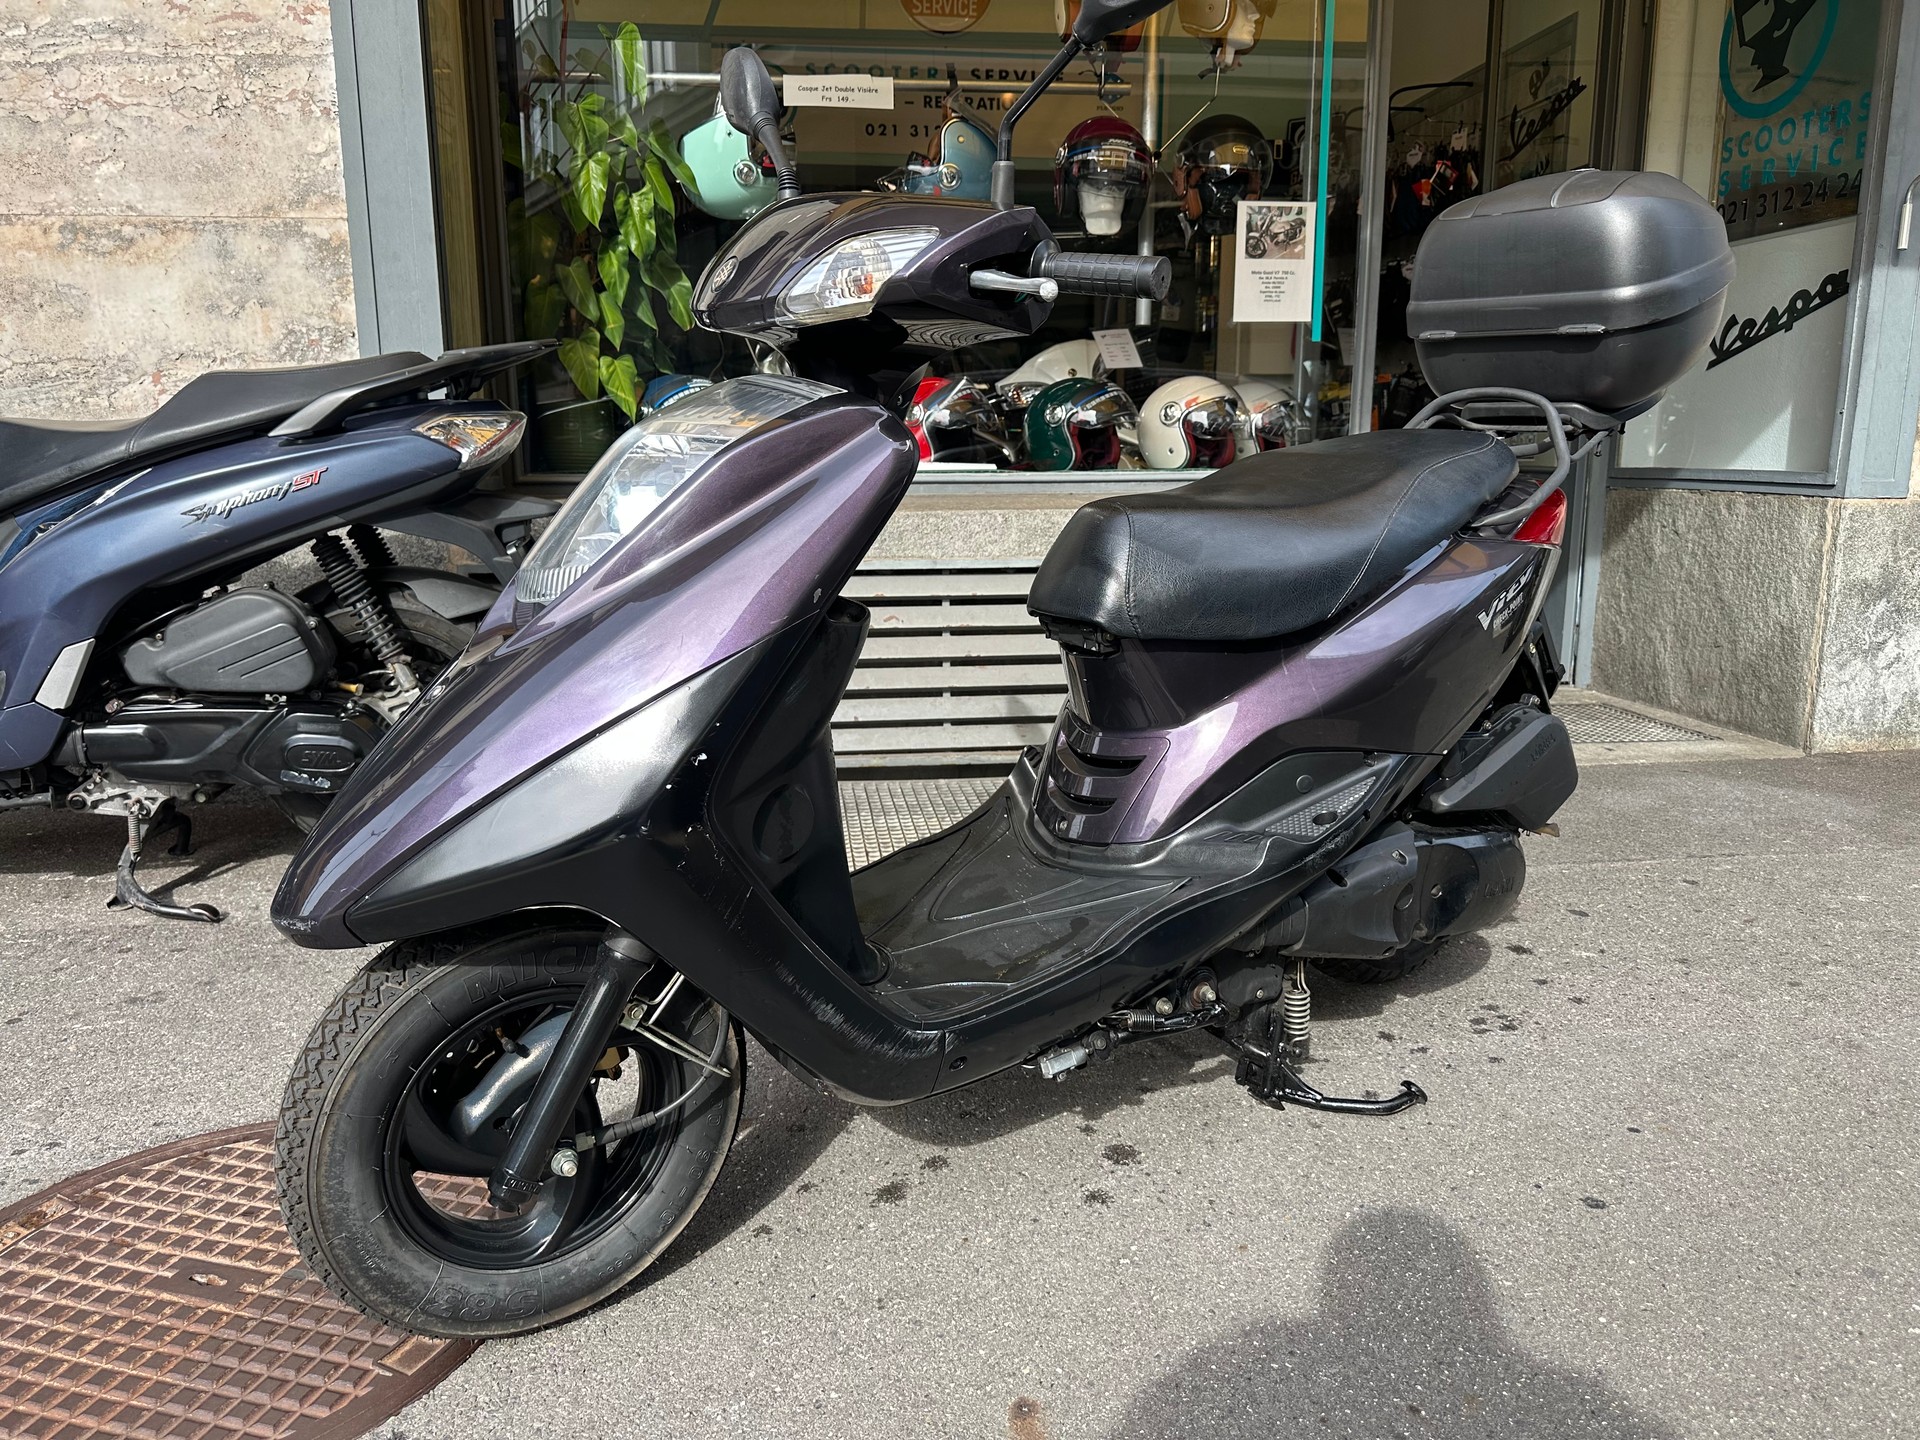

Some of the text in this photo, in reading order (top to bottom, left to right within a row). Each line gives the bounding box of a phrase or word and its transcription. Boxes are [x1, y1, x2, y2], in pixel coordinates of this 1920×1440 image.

[912, 0, 977, 16] SERVICE
[797, 85, 819, 93] Casque
[865, 123, 897, 136] 021
[1721, 91, 1871, 163] SCOOTERS
[1718, 131, 1867, 197] SERVICE
[1756, 186, 1795, 218] 312
[1800, 177, 1829, 207] 24
[1837, 168, 1863, 198] 24
[1705, 268, 1850, 371] Vespa
[291, 466, 329, 492] ST
[1475, 560, 1536, 631] Vity
